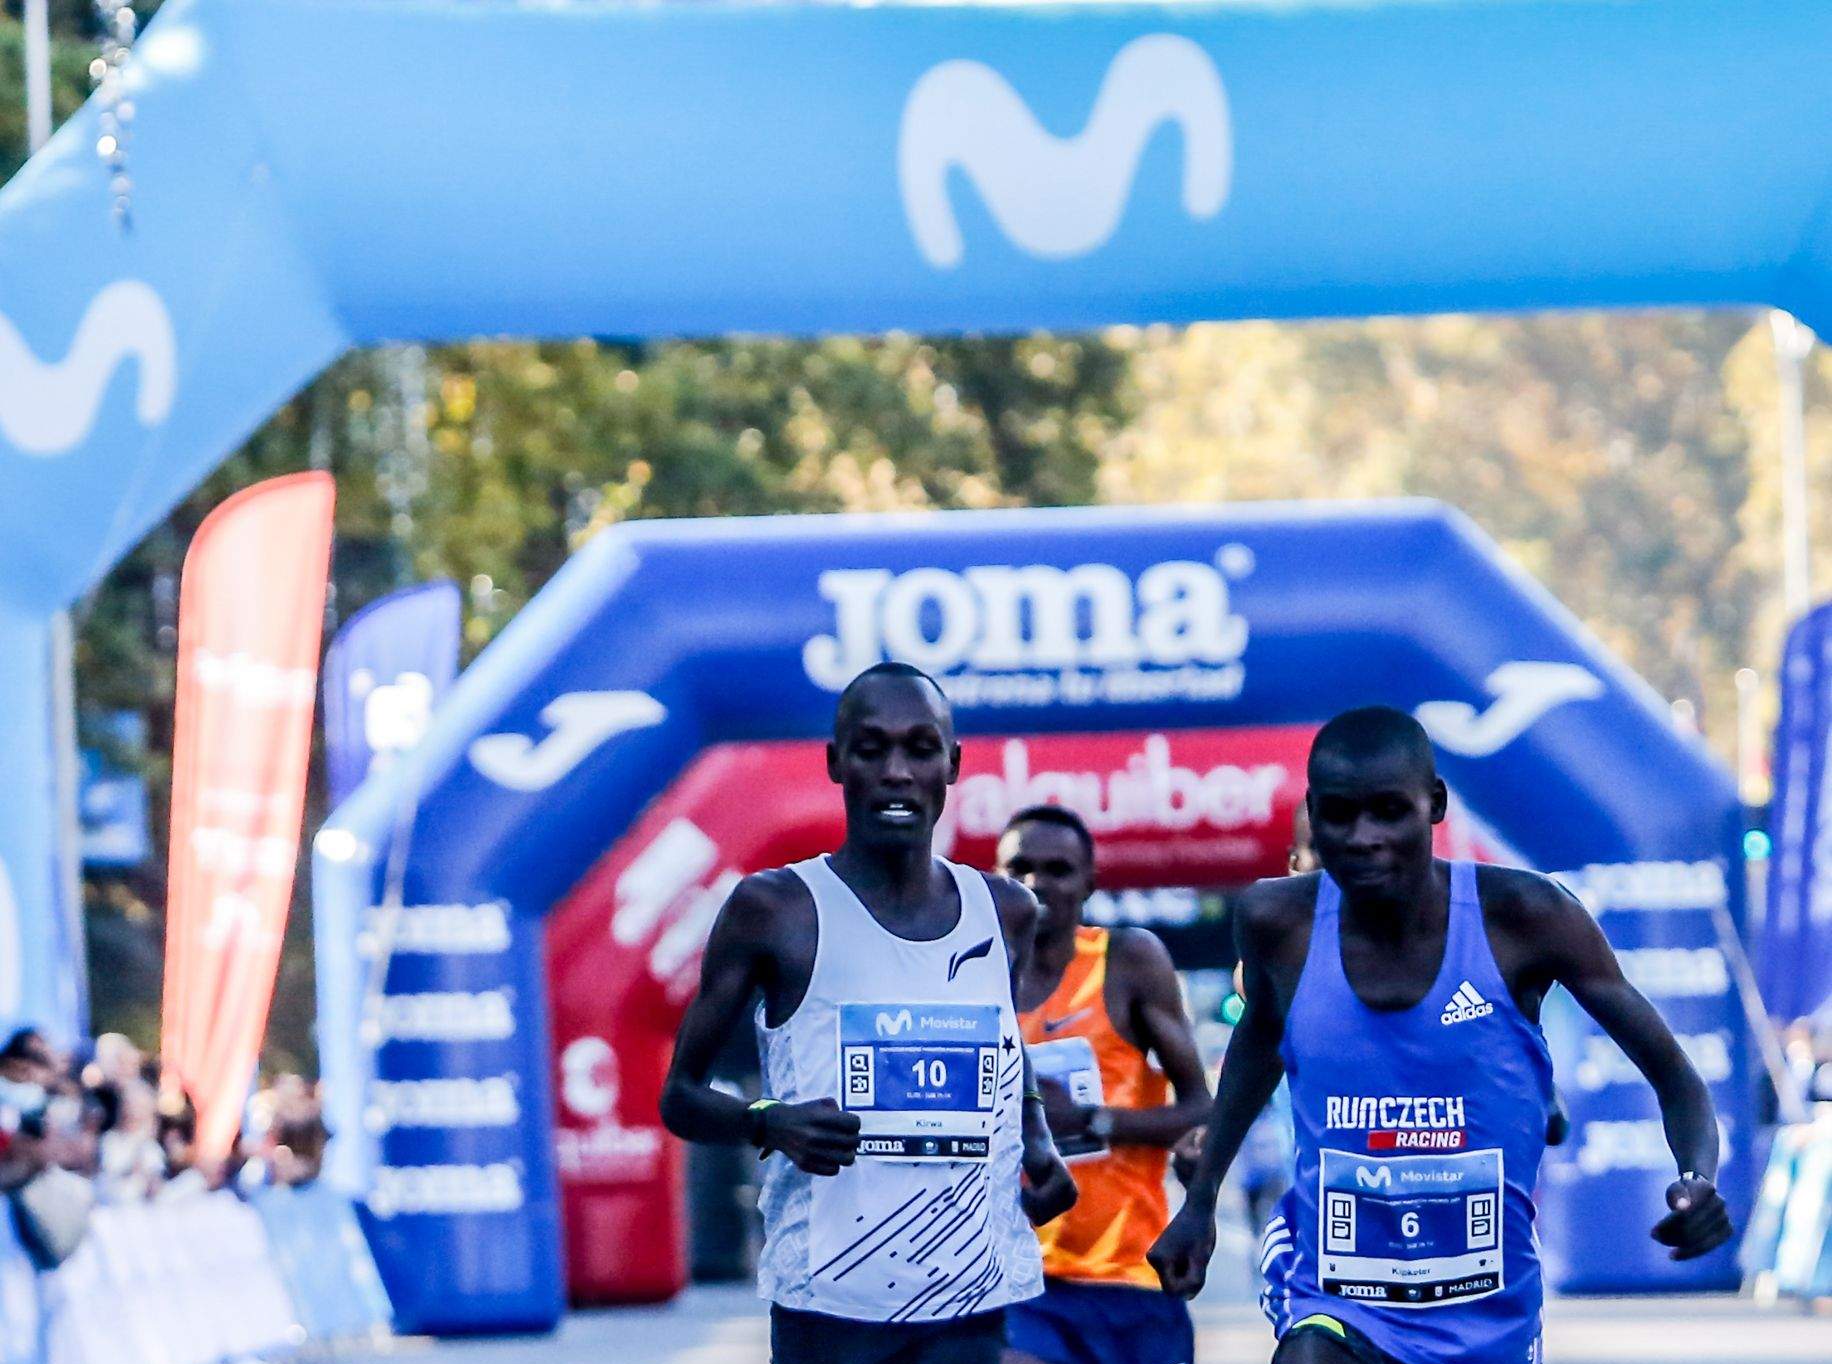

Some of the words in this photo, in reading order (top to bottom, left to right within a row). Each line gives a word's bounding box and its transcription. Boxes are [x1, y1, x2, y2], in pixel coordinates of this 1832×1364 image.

[1440, 1002, 1494, 1026] adidas
[920, 1016, 979, 1030] Movistar
[912, 1059, 947, 1088] 10
[1395, 1131, 1462, 1148] RACING
[1401, 1170, 1464, 1183] Movistar
[1401, 1212, 1420, 1237] 6
[1449, 1278, 1493, 1294] MADRID
